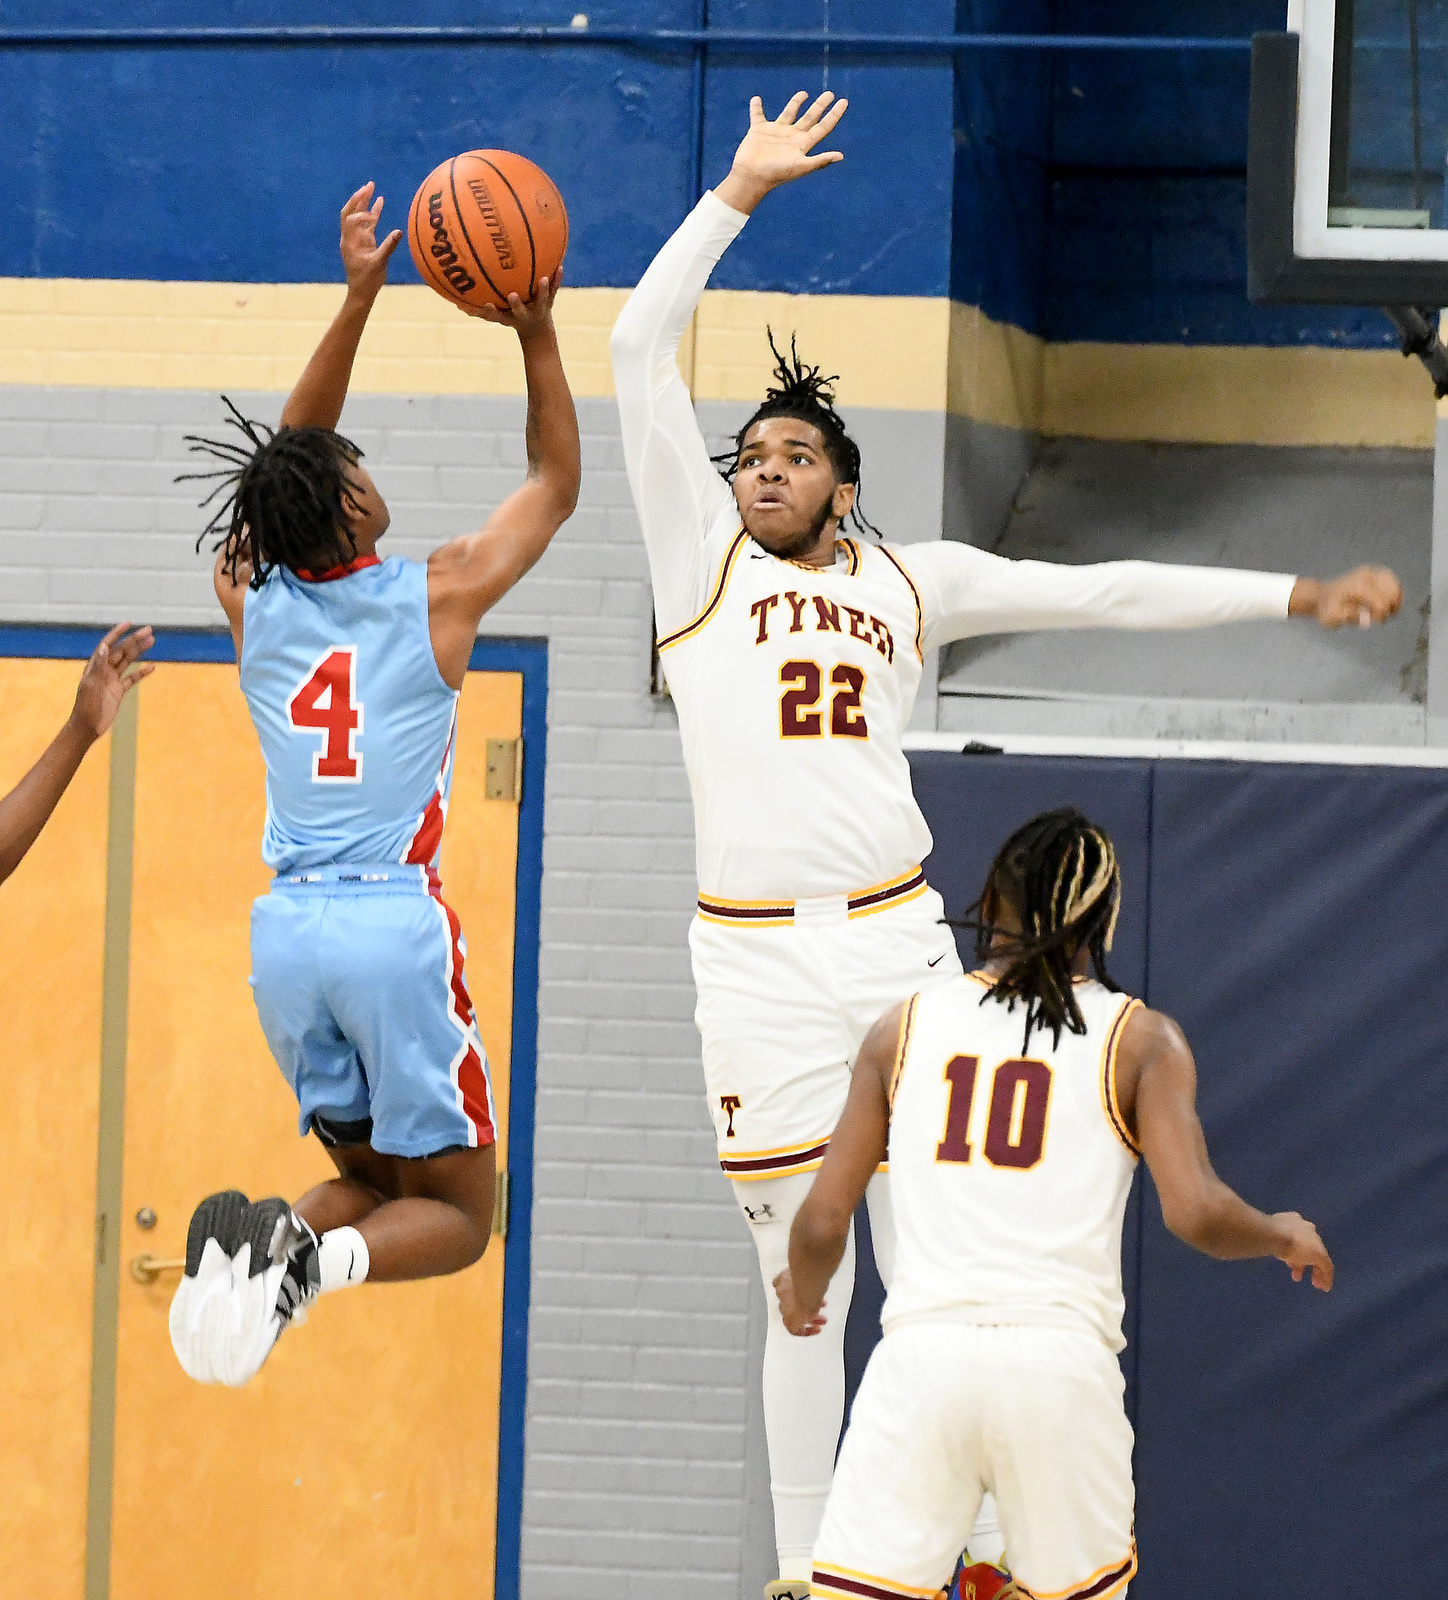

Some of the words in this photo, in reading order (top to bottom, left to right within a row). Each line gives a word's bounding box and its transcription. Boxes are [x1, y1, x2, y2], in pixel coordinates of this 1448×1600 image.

[428, 190, 477, 295] Wilson
[285, 644, 365, 784] 4
[778, 658, 869, 741] 22
[720, 1095, 742, 1138] T
[935, 1054, 1055, 1172] 10
